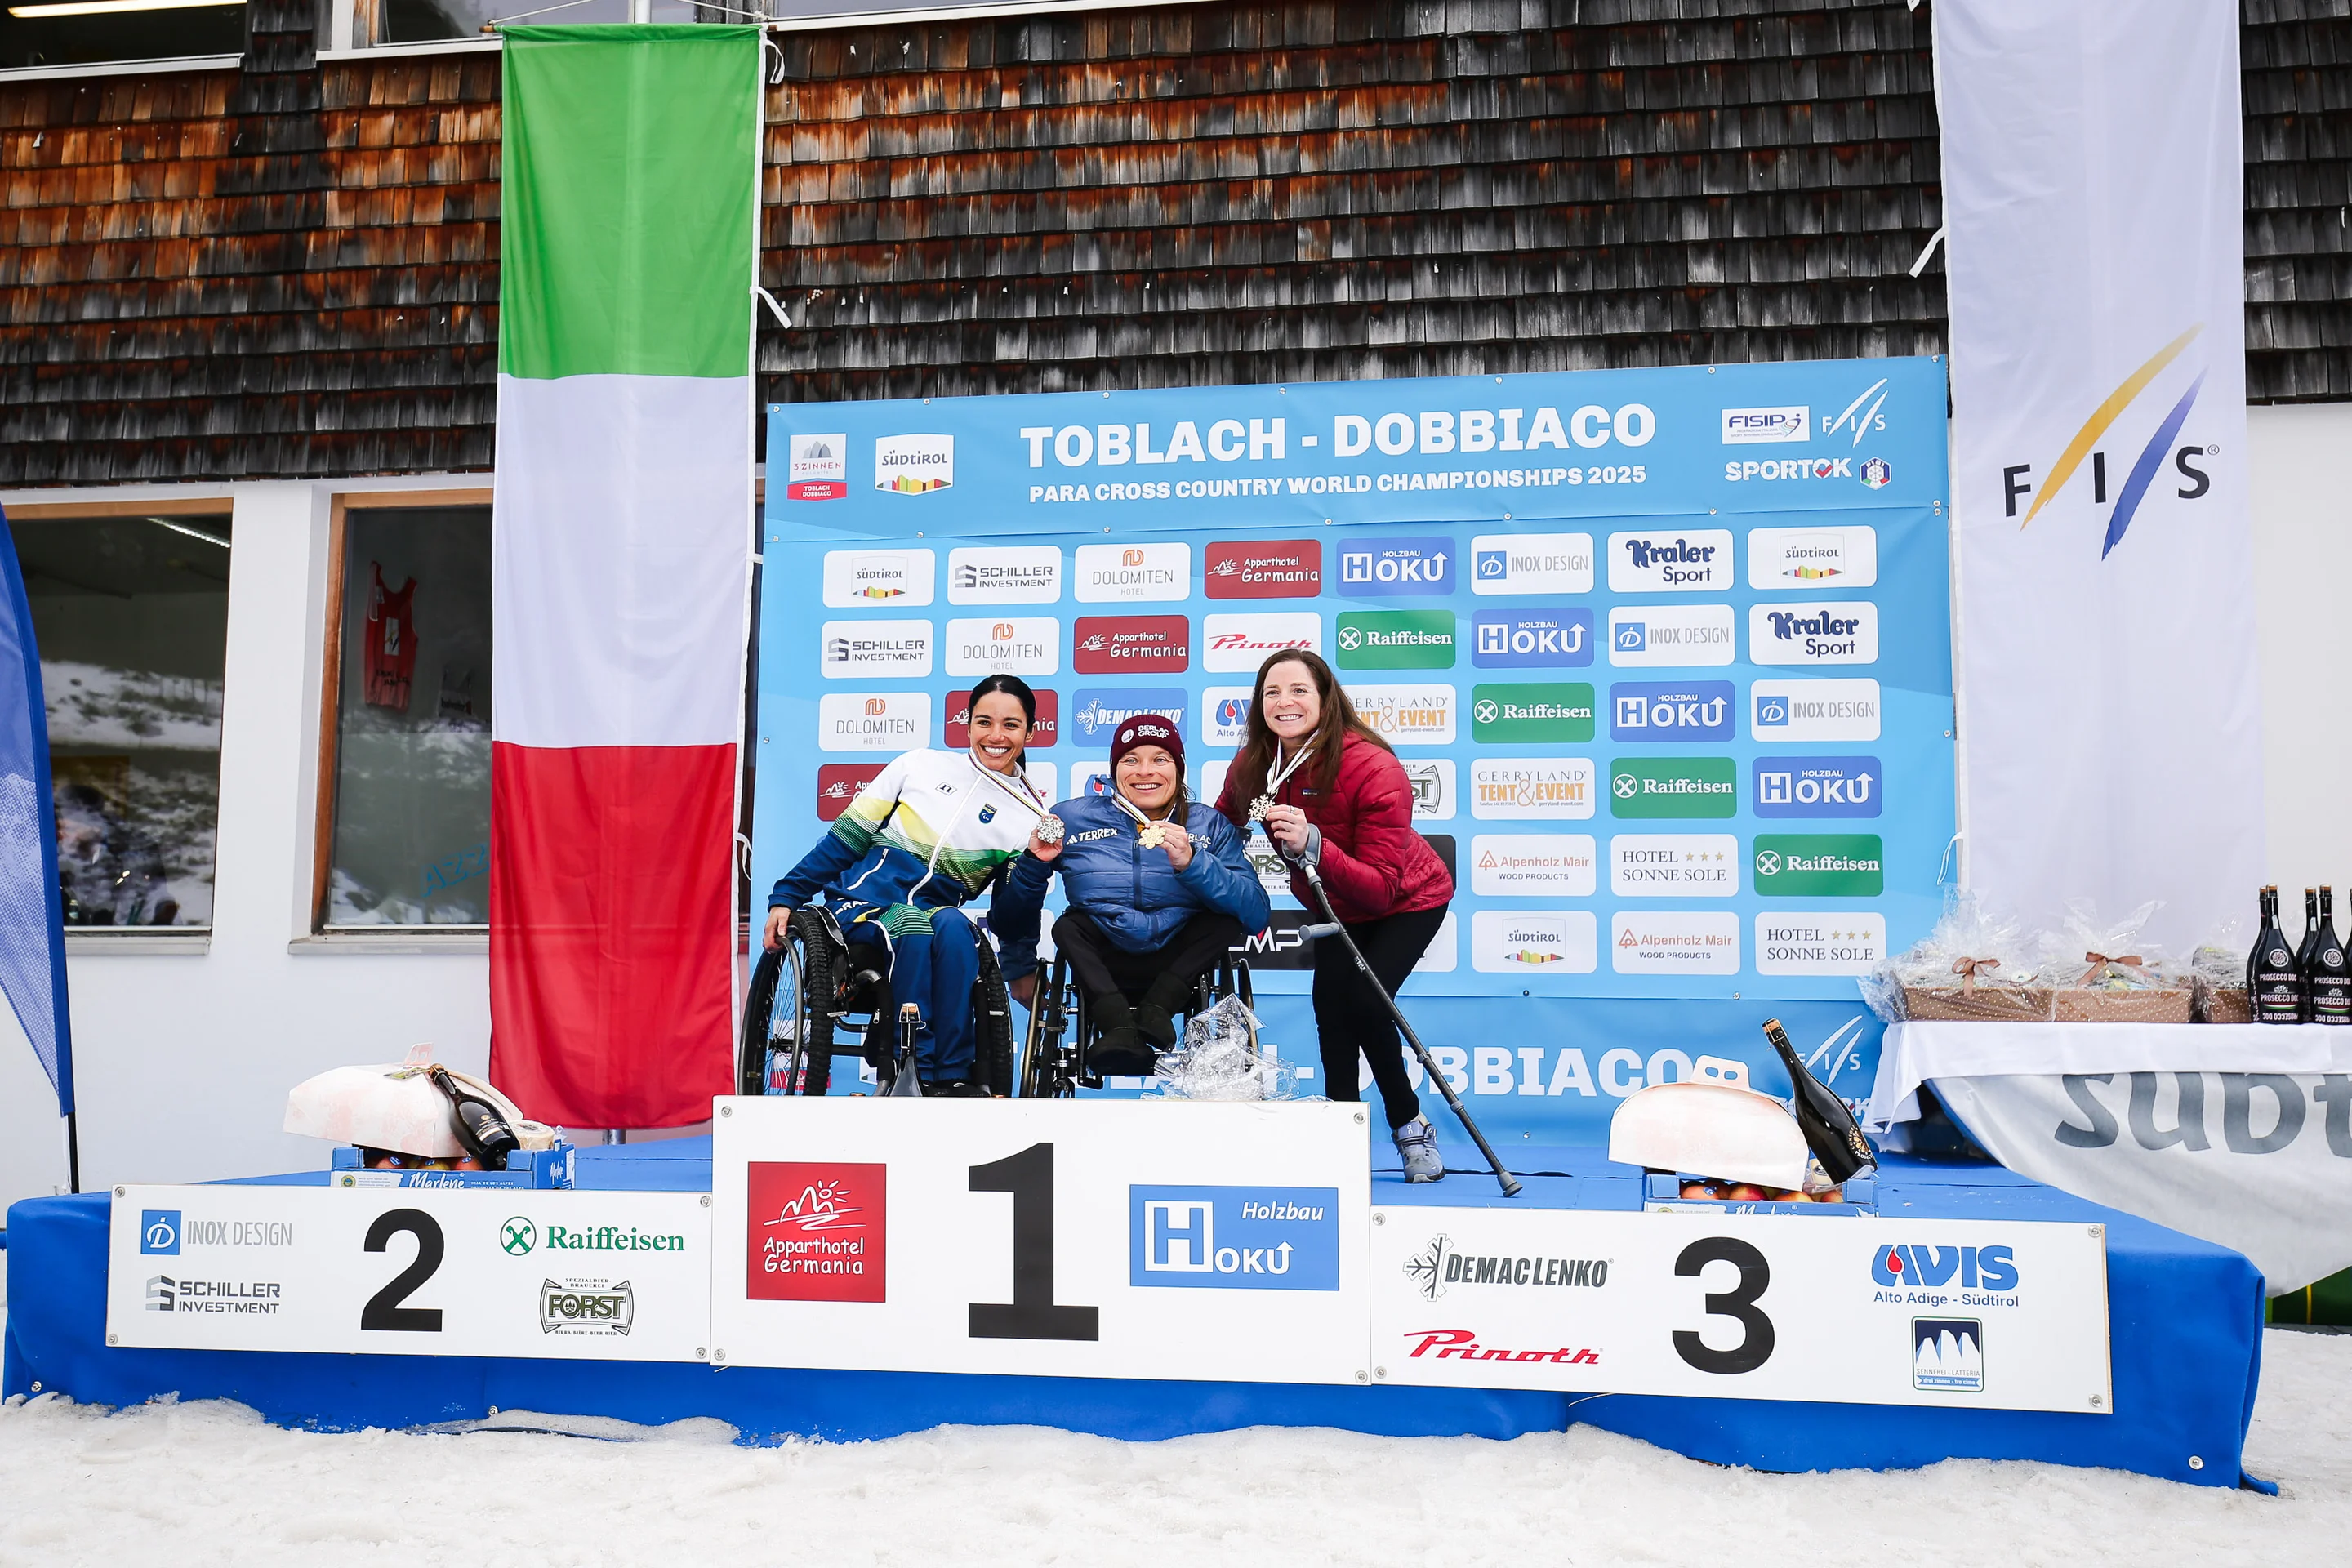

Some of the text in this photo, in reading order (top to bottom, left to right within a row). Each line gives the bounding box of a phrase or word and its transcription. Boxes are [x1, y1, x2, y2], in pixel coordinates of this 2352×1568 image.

[1728, 414, 1786, 428] FISIP
[1821, 413, 1887, 433] FIS
[1019, 417, 1286, 468] TOBLACH
[1334, 403, 1657, 457] DOBBIACO
[1724, 457, 1853, 482] SPORTOK
[1029, 465, 1647, 503] PARA CROSS COUNTRY WORLD CHAMPIONSHIPS 2025
[2003, 445, 2211, 517] FIS
[1244, 555, 1299, 568] Apparthotel
[1382, 550, 1421, 558] HOLZBAU
[1625, 538, 1715, 569] Kraler
[980, 565, 1053, 577] SCHILLER
[1342, 551, 1449, 583] HOKU
[1511, 555, 1588, 572] INOX DESIGN
[979, 578, 1053, 588] INVESTMENT
[1093, 569, 1174, 586] DOLOMITEN
[1241, 569, 1319, 584] Germania
[1662, 565, 1712, 586] Sport
[1518, 621, 1558, 629] HOLZBAU
[1767, 610, 1860, 640] Kraler
[1112, 631, 1167, 644] Apparthotel
[1209, 634, 1312, 650] Prinoth
[1366, 630, 1453, 646] Raiffeisen
[1477, 622, 1587, 654] HOKU
[1650, 627, 1730, 644] INOX DESIGN
[853, 639, 924, 651] SCHILLER
[963, 644, 1043, 660] DOLOMITEN
[1110, 643, 1187, 658] Germania
[1805, 638, 1855, 657] Sport
[852, 652, 924, 662] INVESTMENT
[1356, 697, 1446, 707] ERRYLAND
[1793, 701, 1875, 718] INOX DESIGN
[1399, 709, 1446, 726] EVENT
[1503, 703, 1592, 719] Raiffeisen
[1615, 695, 1728, 728] HOKU
[836, 719, 915, 734] DOLOMITEN
[1138, 724, 1169, 736] BERLAC
[1138, 730, 1168, 738] GROUP
[1477, 770, 1584, 782] GERRYLAND
[1478, 784, 1517, 802] TENT
[1535, 782, 1585, 800] EVENT
[1642, 777, 1734, 795] Raiffeisen
[1759, 771, 1874, 804] HOKU
[1078, 827, 1118, 844] TERREX
[1501, 856, 1589, 869] Alpenholz Mair
[1622, 850, 1678, 863] HOTEL
[1787, 855, 1880, 872] Raiffeisen
[1622, 869, 1726, 882] SONNE SOLE
[1228, 926, 1304, 954] MP
[1641, 934, 1732, 947] Alpenholz Mair
[1767, 929, 1825, 942] HOTEL
[1766, 947, 1874, 960] SONNE SOLE
[409, 1171, 465, 1189] Marlene
[1241, 1200, 1325, 1221] Holzbau
[187, 1221, 293, 1247] INOX DESIGN
[546, 1225, 686, 1251] Raiffeisen
[968, 1142, 1099, 1341] 1
[1144, 1200, 1295, 1275] HOKU
[762, 1236, 865, 1259] Apparthotel
[361, 1208, 445, 1332] 2
[764, 1255, 865, 1276] Germania
[1445, 1253, 1609, 1288] DEMACLENKO
[1871, 1244, 2020, 1291] AVIS
[180, 1281, 281, 1298] SCHILLER
[548, 1294, 626, 1319] FORST
[1671, 1236, 1776, 1375] 3
[1873, 1290, 1903, 1304] Alto
[1907, 1292, 1949, 1307] Adige
[1962, 1293, 2020, 1307] Südtirol
[178, 1301, 280, 1314] INVESTMENT
[1403, 1329, 1601, 1365] Prinoth
[1916, 1368, 1946, 1376] SENNEREI
